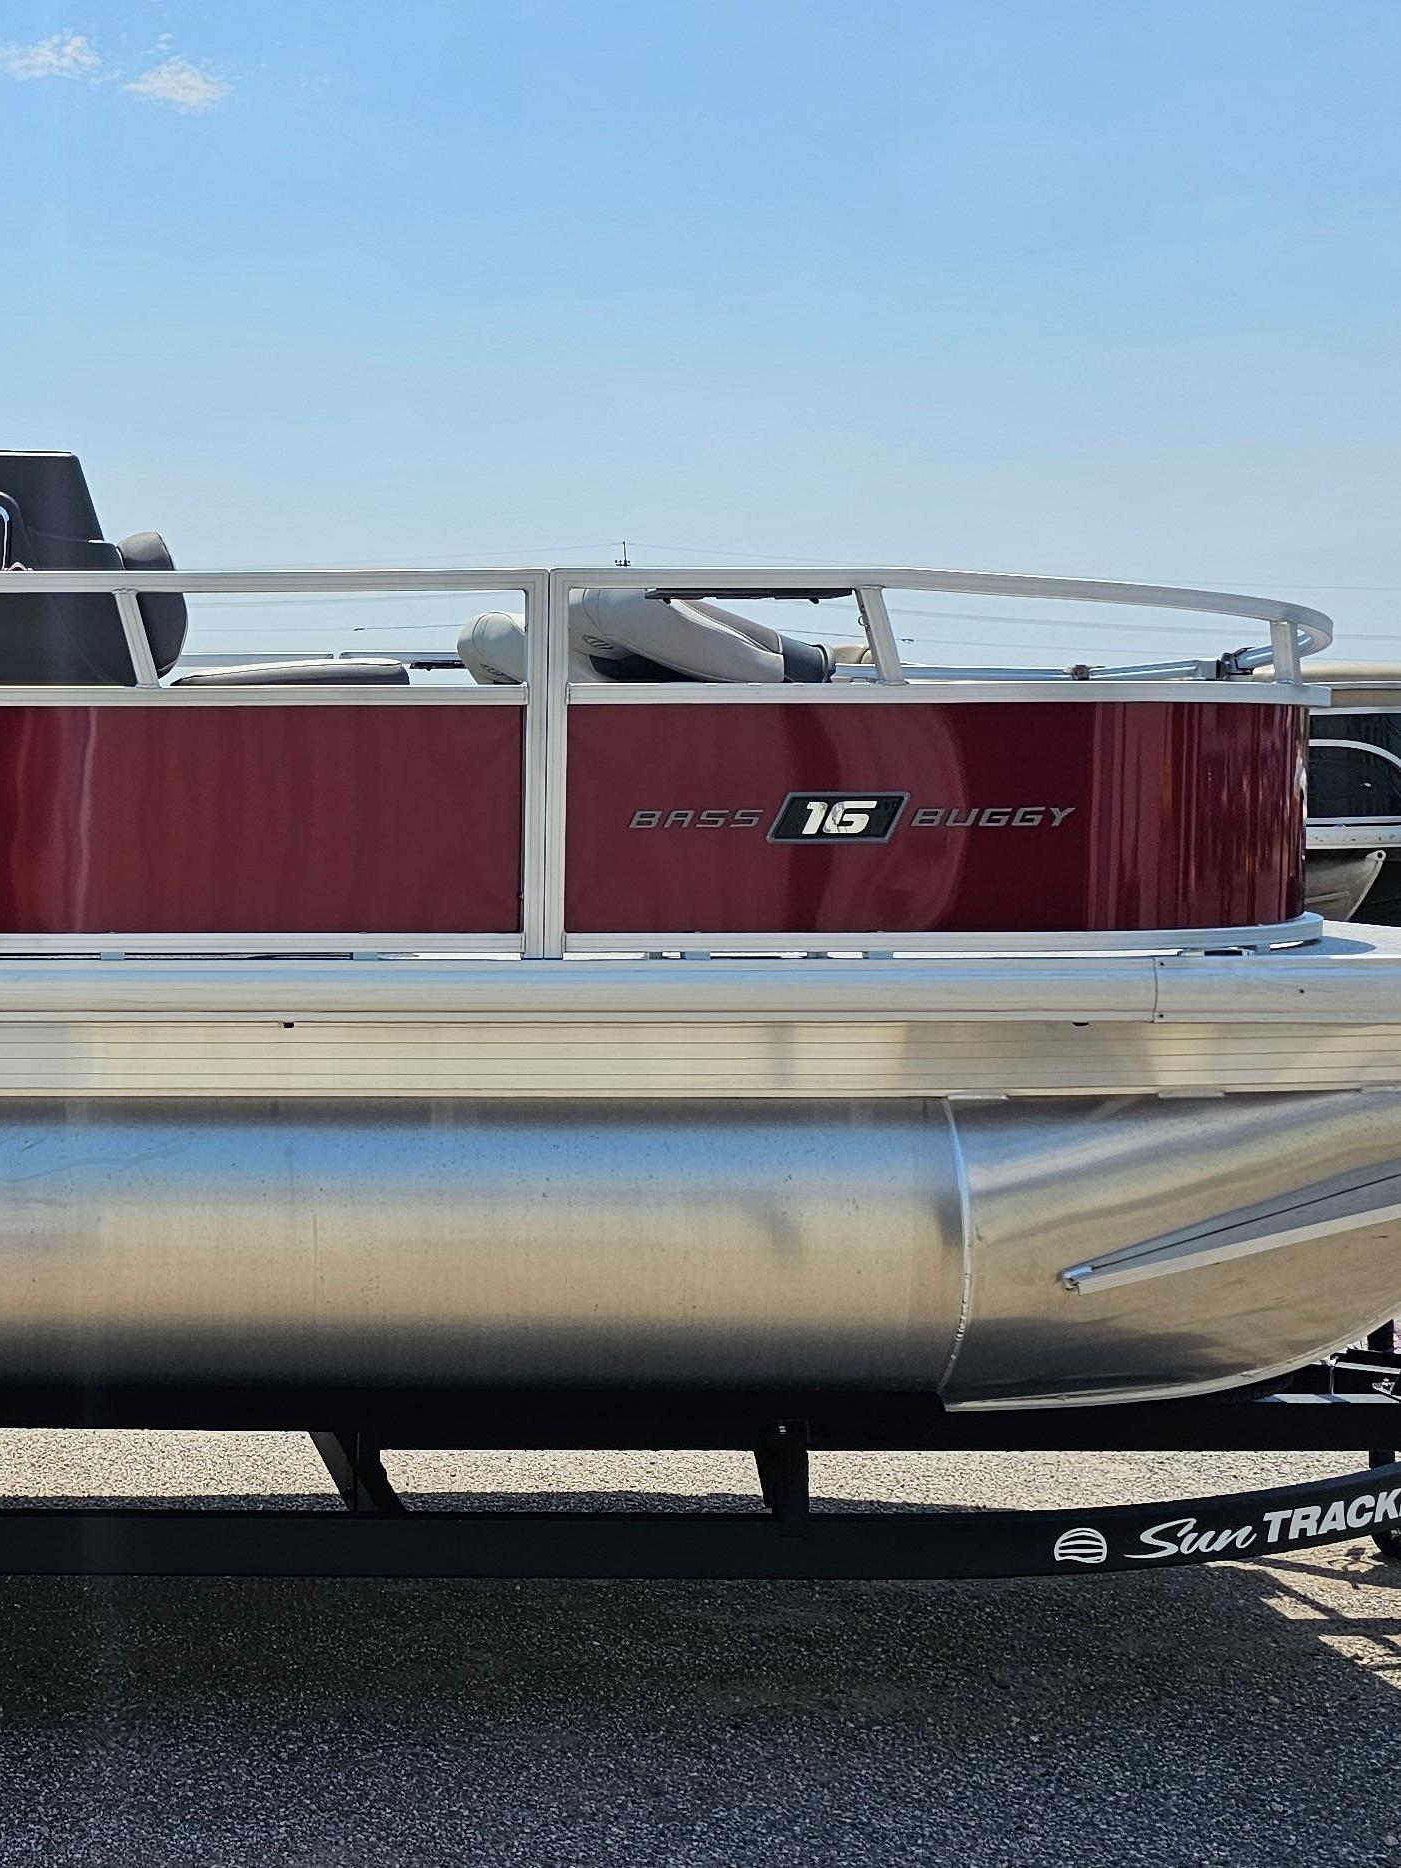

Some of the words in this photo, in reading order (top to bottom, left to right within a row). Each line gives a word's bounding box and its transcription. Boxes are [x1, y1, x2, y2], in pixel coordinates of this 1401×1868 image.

[629, 809, 763, 829] BASS
[801, 801, 878, 835] 16
[911, 806, 1075, 828] BUGGY
[1124, 1518, 1258, 1559] Sun
[1263, 1488, 1401, 1543] TRACK
